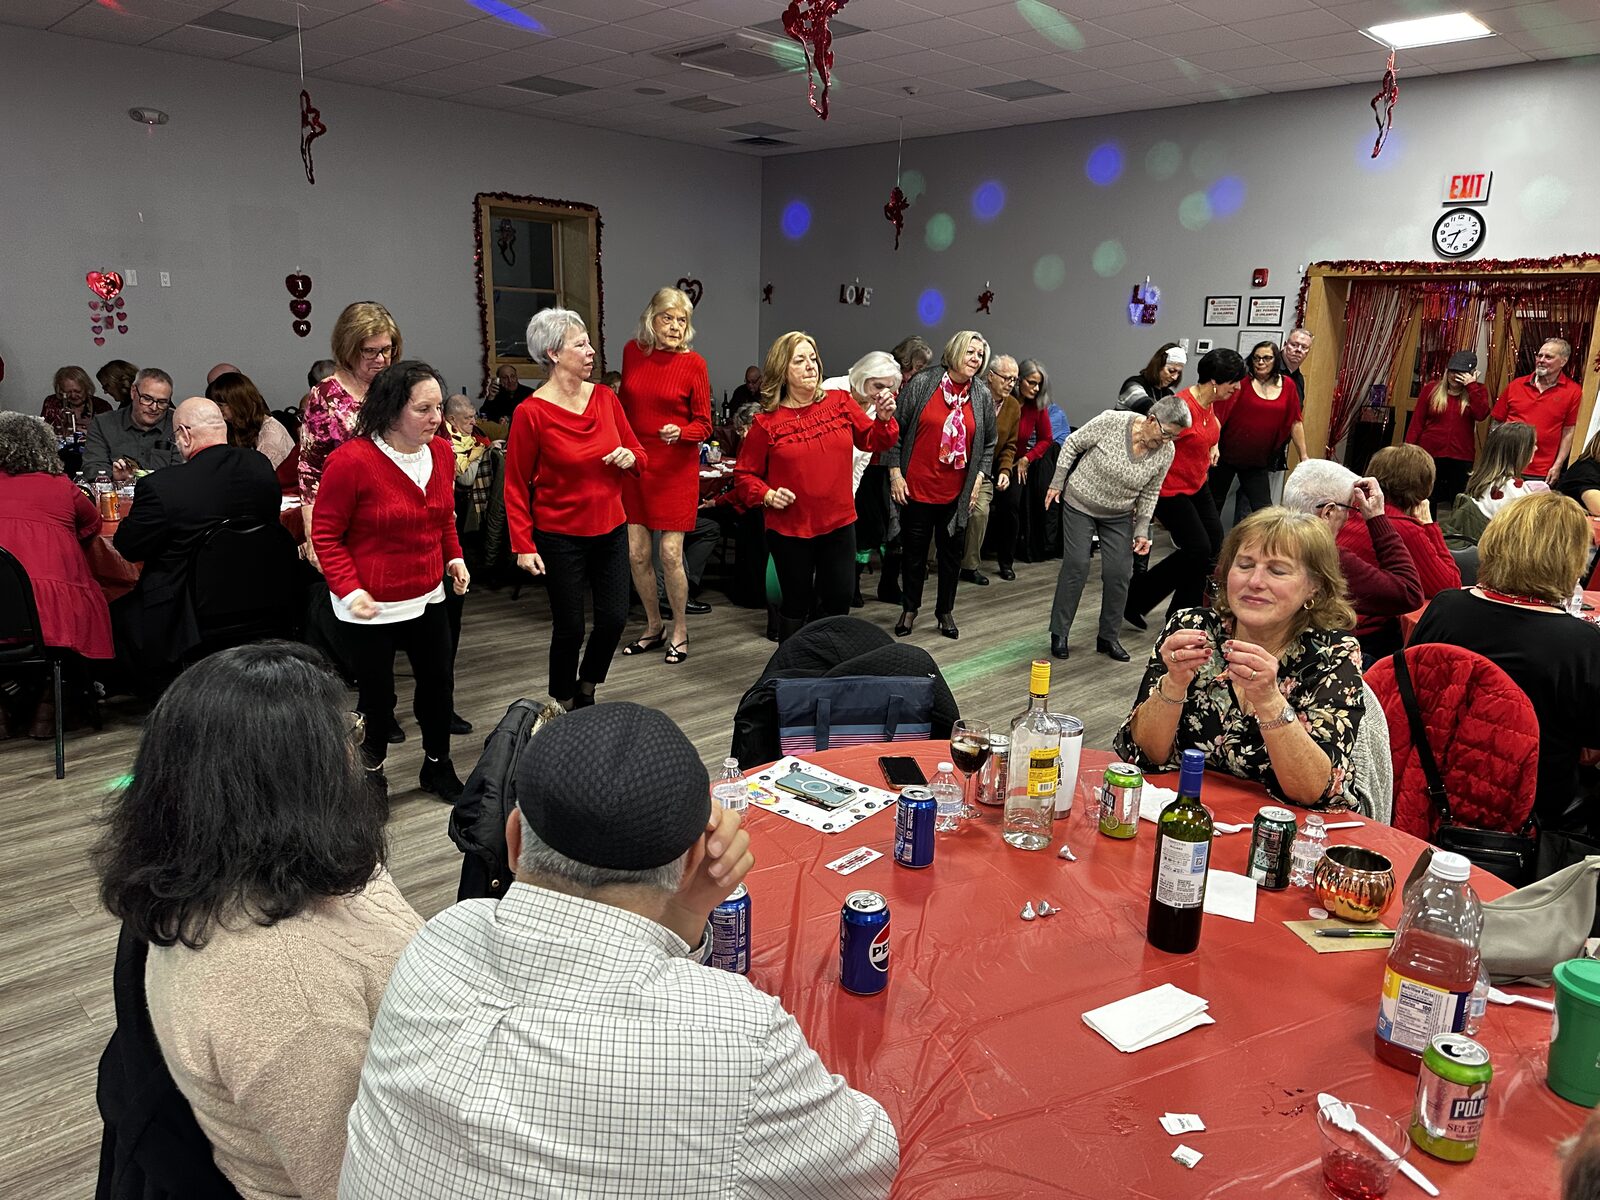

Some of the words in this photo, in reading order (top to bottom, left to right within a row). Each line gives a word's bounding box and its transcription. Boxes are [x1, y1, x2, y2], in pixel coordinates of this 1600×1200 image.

[1449, 174, 1485, 199] EXIT
[840, 284, 873, 306] LOVE
[1421, 990, 1434, 998] Facts
[1422, 1004, 1432, 1012] 100
[1454, 1099, 1486, 1118] POLA
[1447, 1123, 1479, 1133] SELTZ
